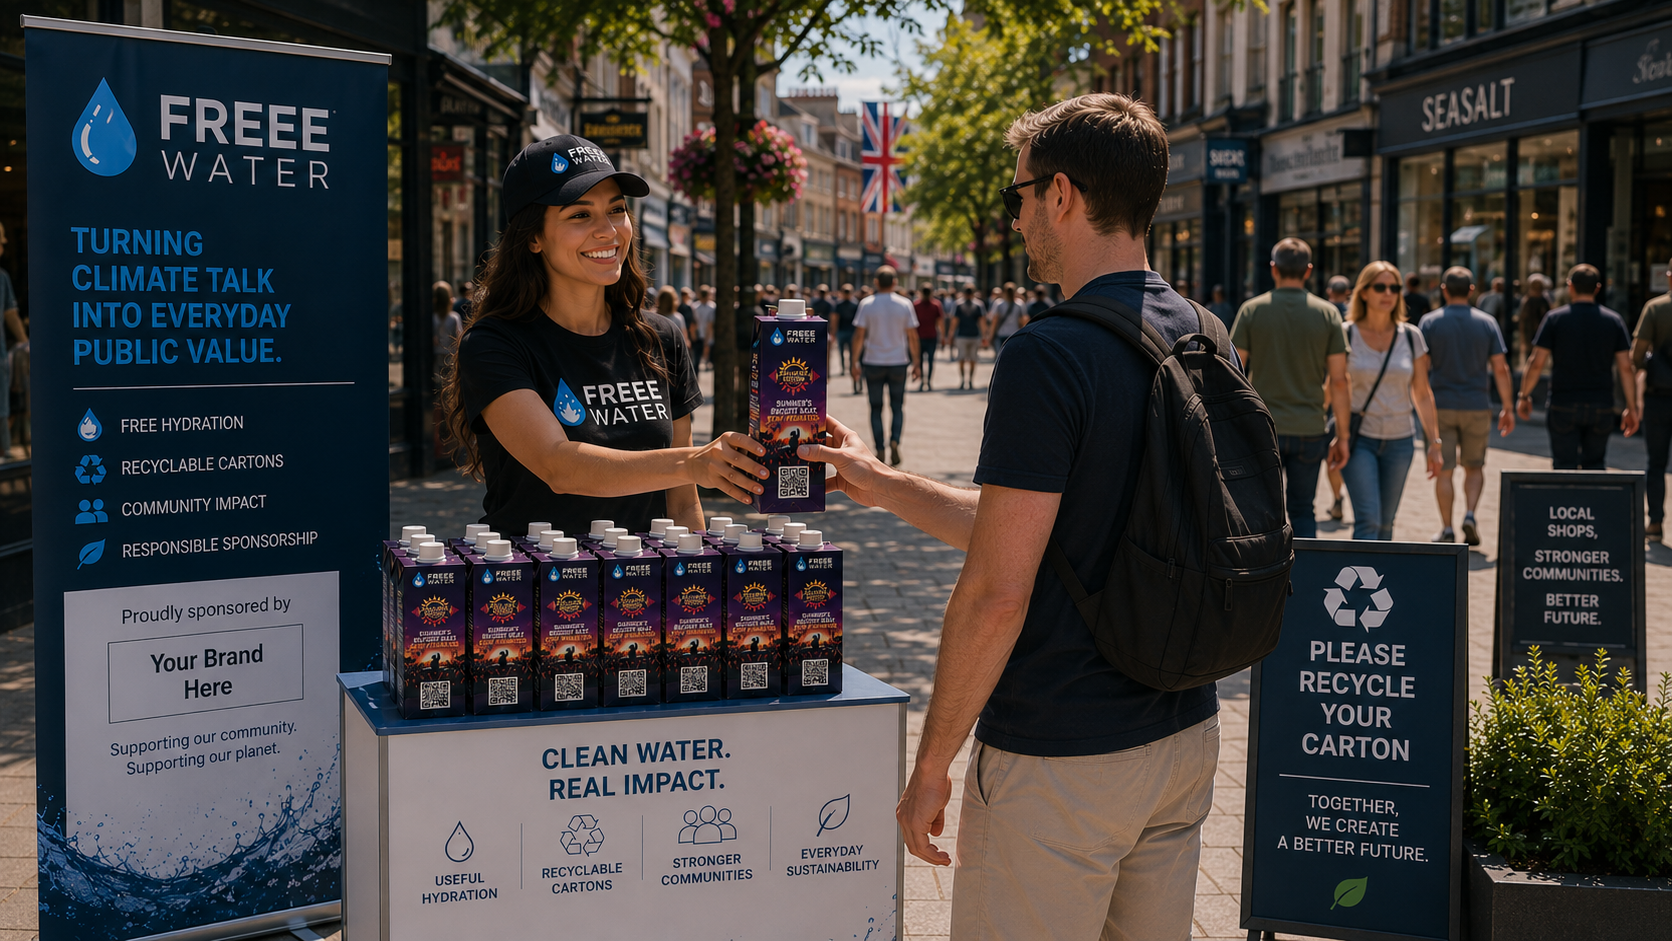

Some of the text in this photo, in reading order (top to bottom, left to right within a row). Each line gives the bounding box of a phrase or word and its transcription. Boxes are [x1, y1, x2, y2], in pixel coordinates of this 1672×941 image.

[1421, 76, 1515, 133] SEASALT
[160, 94, 330, 153] FREEE
[161, 149, 330, 190] WATER
[71, 227, 203, 257] TURNING
[71, 265, 274, 294] CLIMATE TALK
[73, 301, 292, 329] INTO EVERYDAY
[73, 337, 282, 366] PUBLIC VALUE.
[582, 379, 663, 406] FREEE
[121, 415, 244, 433] FREE HYDRATION
[589, 402, 669, 426] WATER
[121, 453, 284, 476] RECYCLABLE CARTONS
[121, 494, 267, 517] COMMUNITY IMPACT
[1549, 506, 1595, 521] LOCAL
[122, 530, 319, 558] RESPONSIBLE SPONSORSHIP
[1547, 524, 1598, 540] SHOPS,
[1534, 549, 1610, 565] STRONGER
[1522, 567, 1624, 583] COMMUNITIES.
[122, 596, 291, 625] Proudly sponsored by
[1545, 593, 1600, 608] BETTER
[1543, 610, 1602, 626] FUTURE.
[150, 643, 263, 674] Your Brand
[1310, 640, 1406, 667] PLEASE
[184, 678, 233, 700] Here
[1299, 670, 1416, 699] RECYCLE
[1320, 703, 1392, 729] YOUR
[110, 720, 297, 758] Supporting our community.
[1301, 733, 1410, 762] CARTON
[126, 742, 281, 776] Supporting our planet.
[541, 738, 731, 770] CLEAN WATER.
[549, 768, 725, 801] REAL IMPACT.
[1307, 794, 1400, 817] TOGETHER,
[1305, 815, 1400, 838] WE CREATE
[672, 853, 742, 869] STRONGER
[801, 844, 864, 860] EVERYDAY
[1277, 835, 1429, 863] A BETTER FUTURE.
[435, 872, 485, 887] USEFUL
[542, 862, 623, 880] RECYCLABLE
[661, 868, 753, 886] COMMUNITIES
[786, 859, 880, 877] SUSTAINABILITY
[422, 889, 498, 905] HYDRATION
[551, 879, 613, 895] CARTONS
